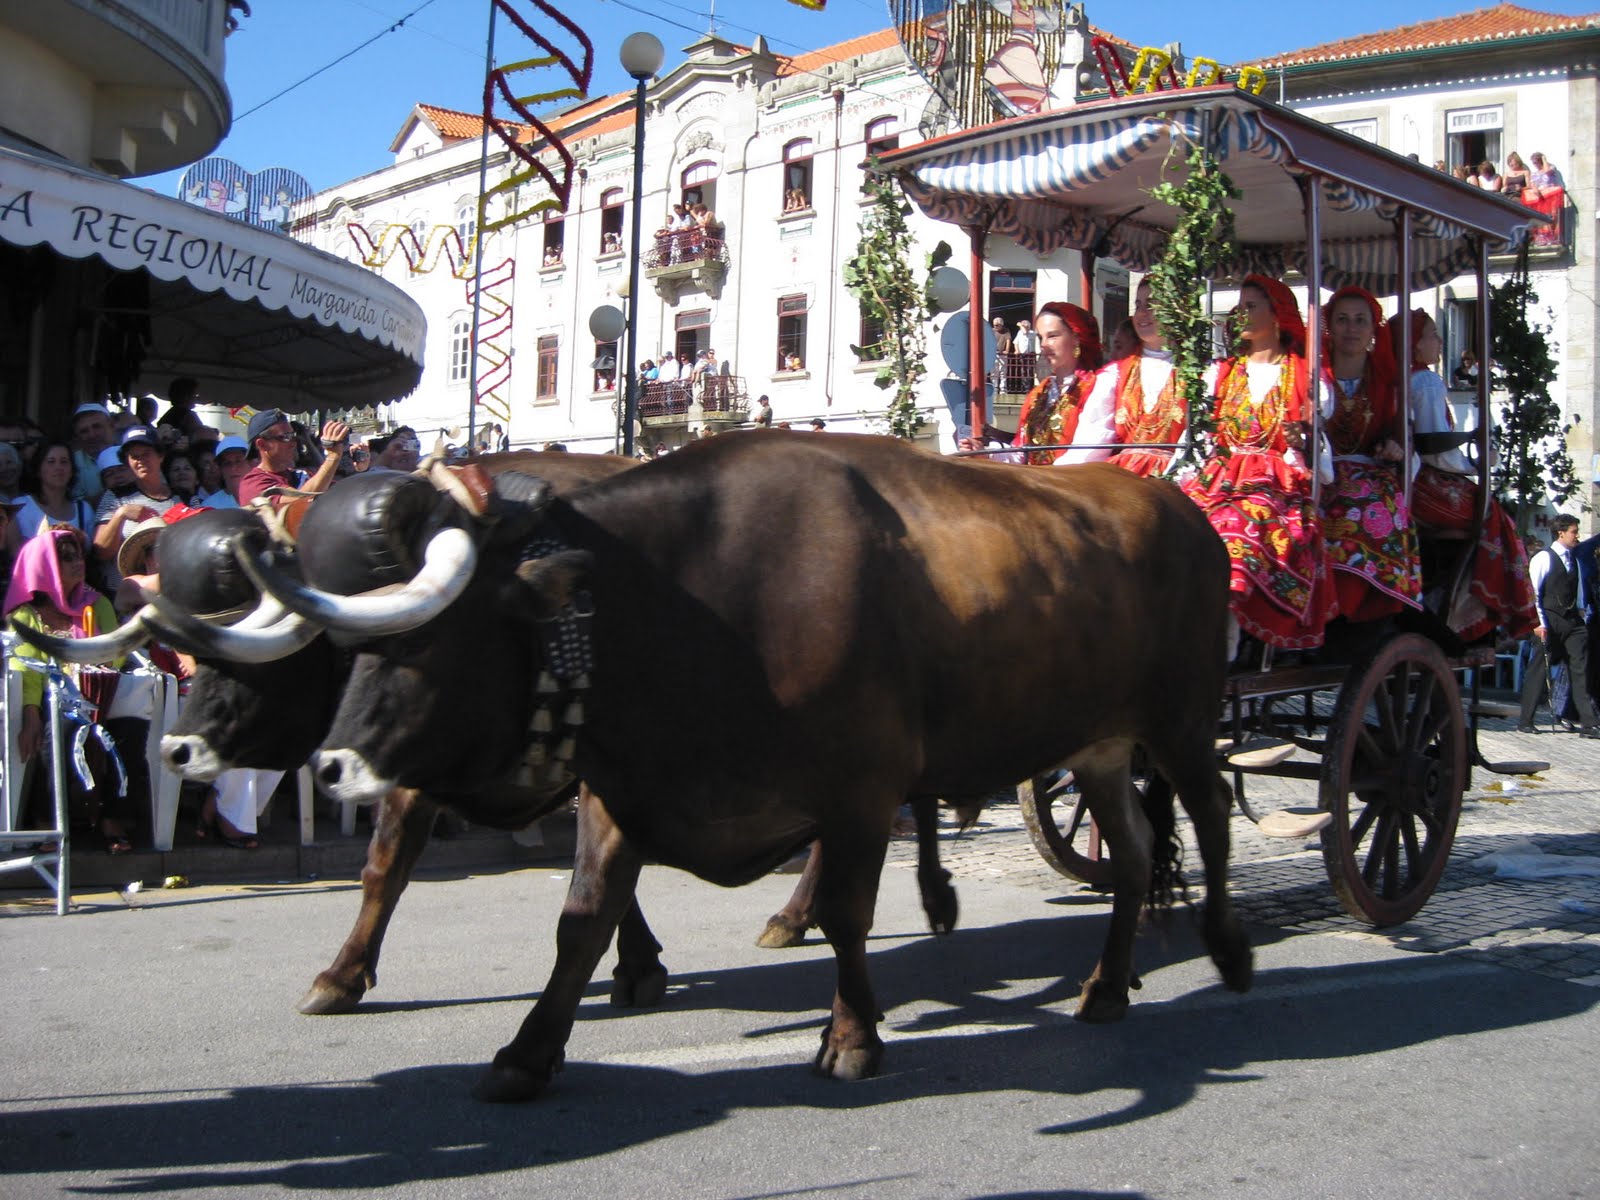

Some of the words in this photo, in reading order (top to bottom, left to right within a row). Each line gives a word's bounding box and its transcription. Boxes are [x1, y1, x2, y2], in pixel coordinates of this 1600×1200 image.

[0, 184, 33, 227] A
[72, 205, 272, 291] REGIONAL
[290, 272, 378, 325] Margarida
